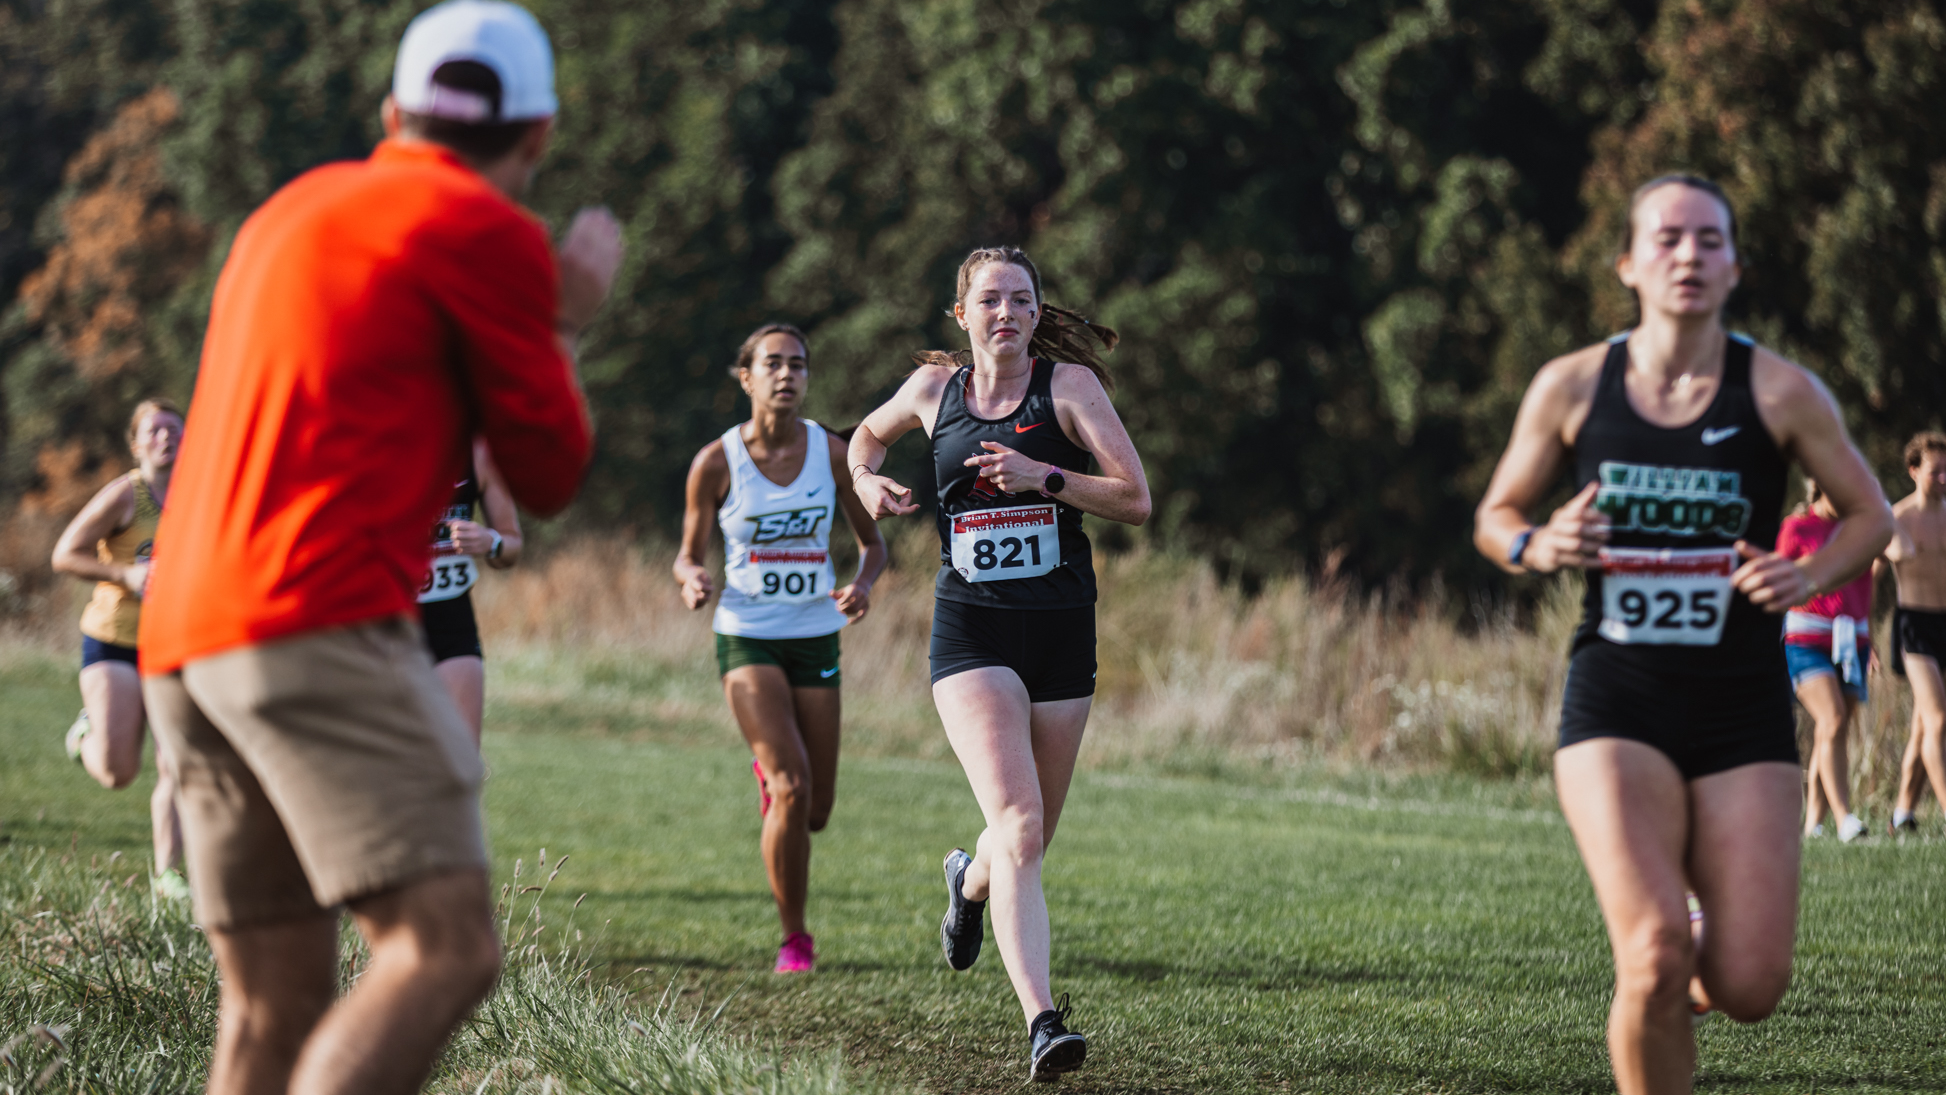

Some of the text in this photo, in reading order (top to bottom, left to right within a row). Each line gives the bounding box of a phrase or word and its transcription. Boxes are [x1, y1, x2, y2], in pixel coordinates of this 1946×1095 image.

[961, 511, 988, 523] Brian
[1000, 508, 1048, 518] Simpson
[965, 518, 1045, 533] Invitational
[973, 534, 1041, 571] 821
[763, 571, 817, 595] 901
[1618, 588, 1719, 630] 925
